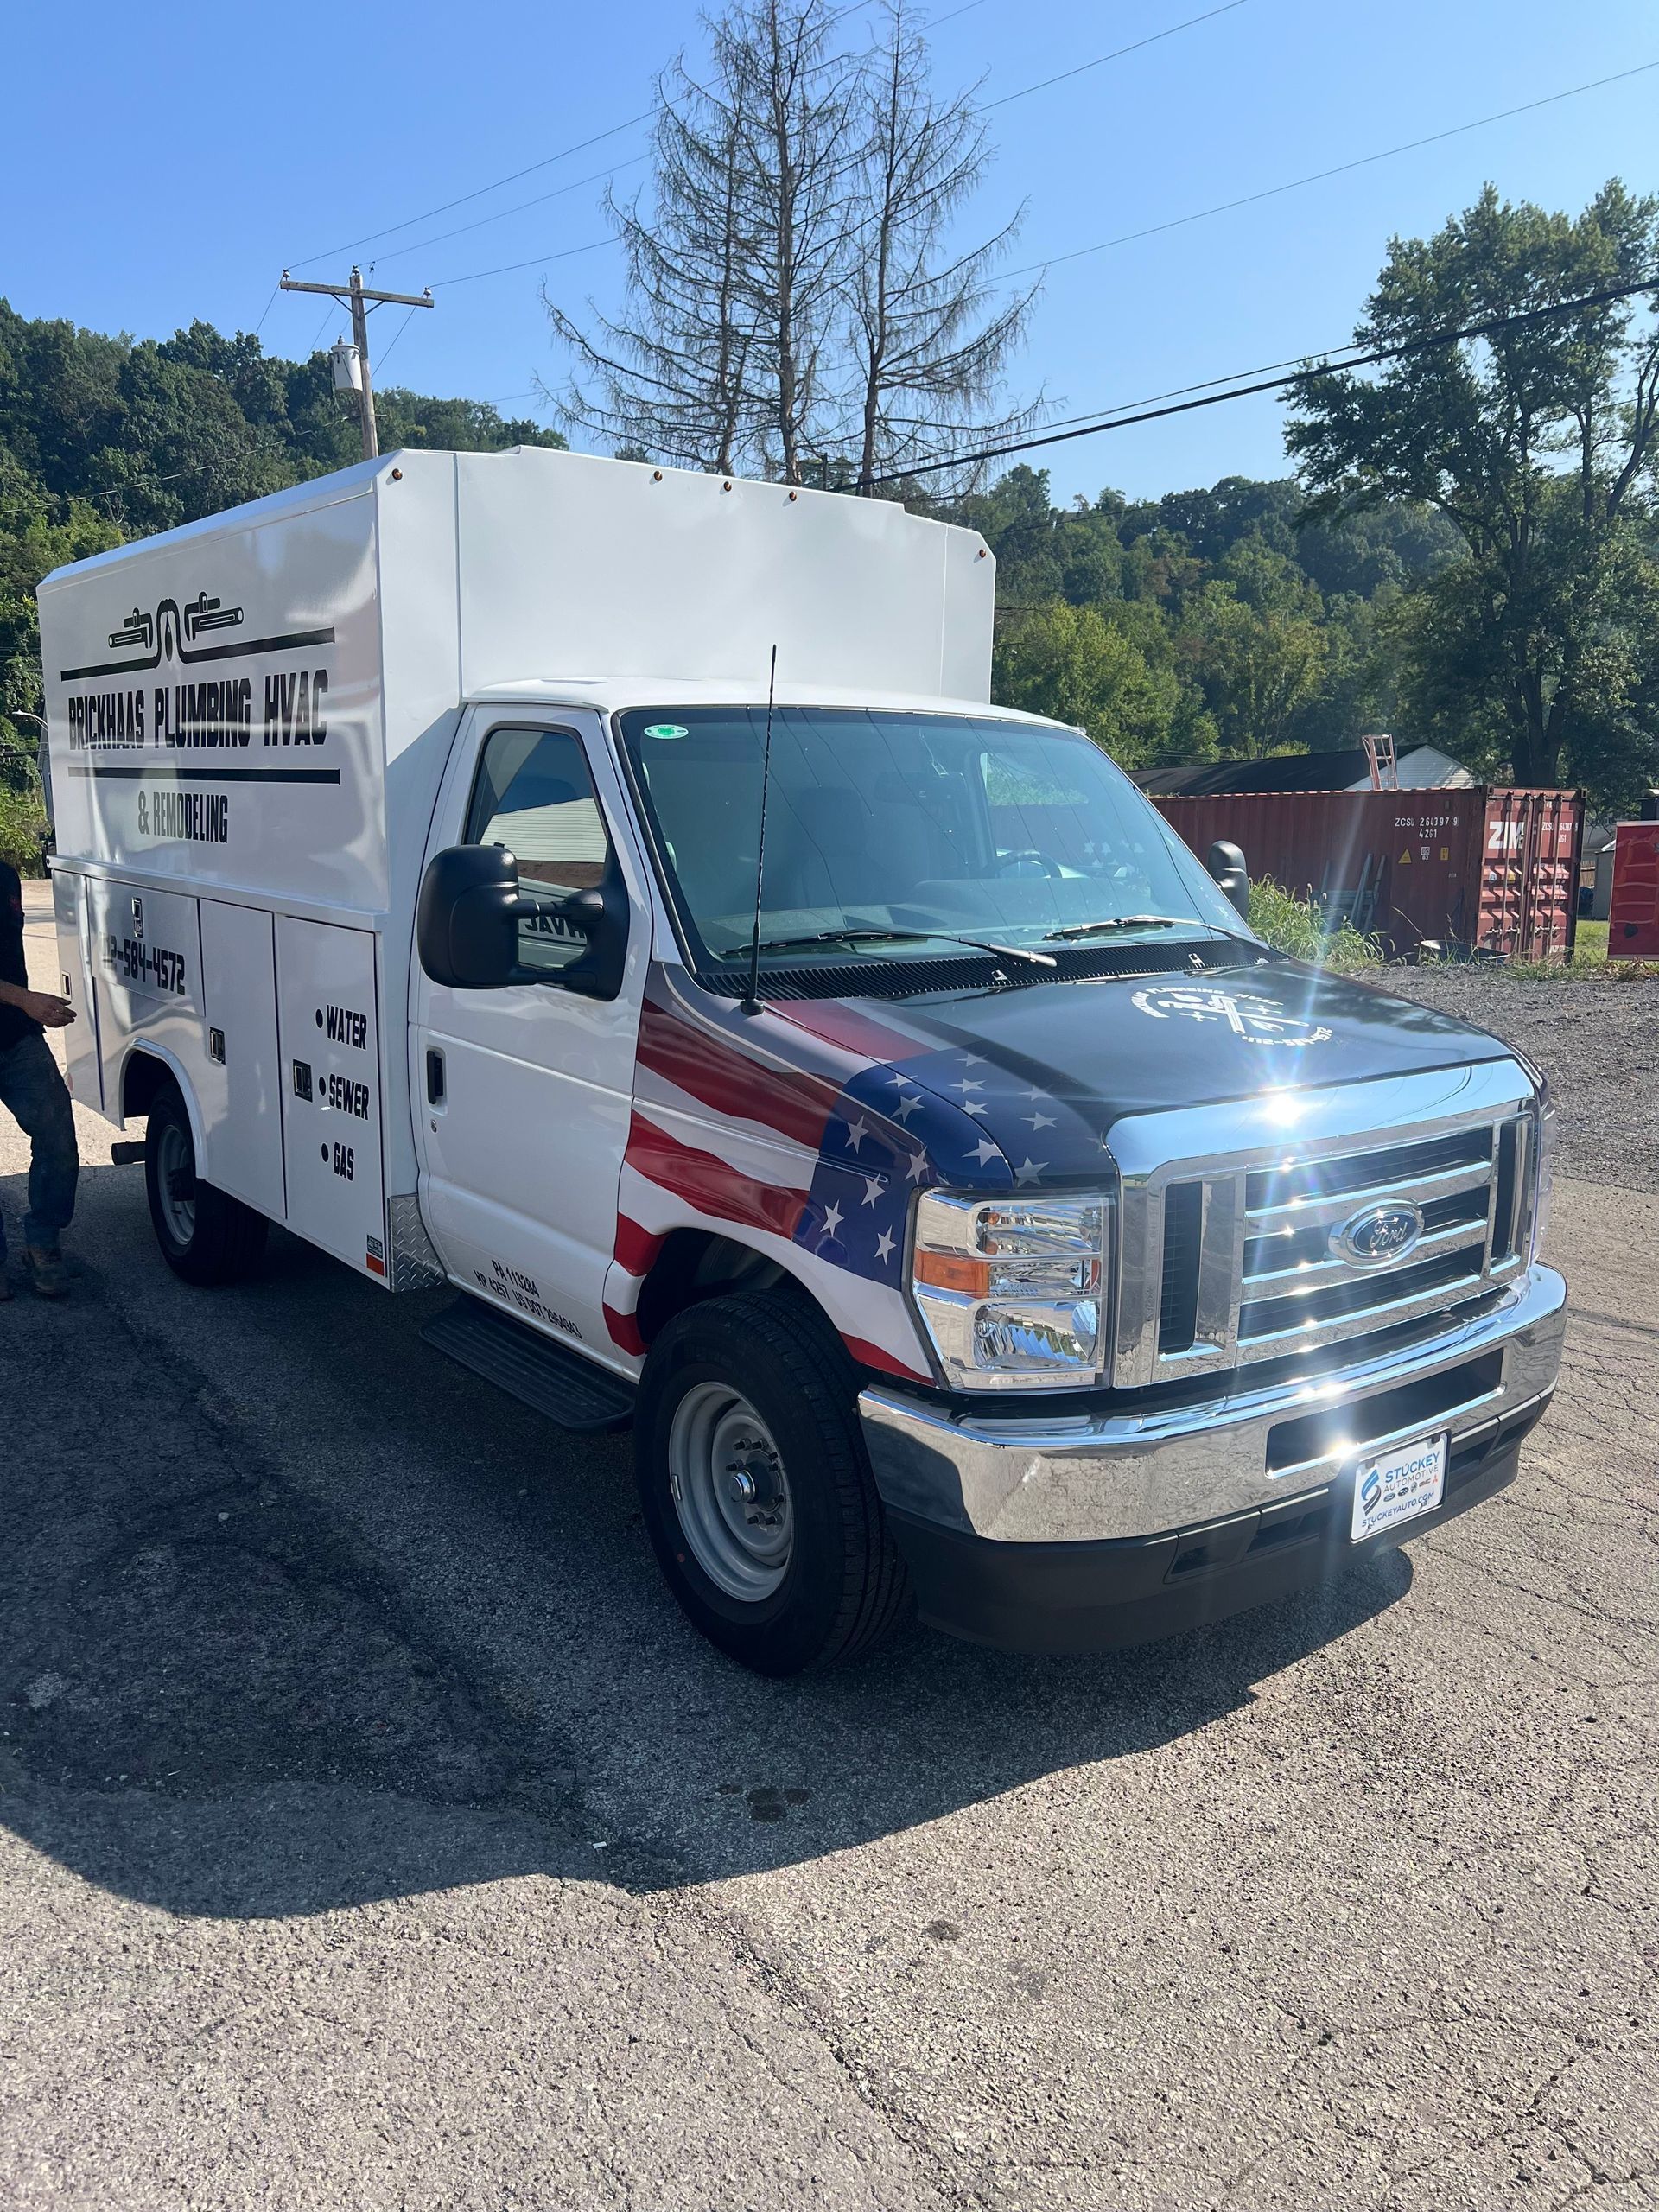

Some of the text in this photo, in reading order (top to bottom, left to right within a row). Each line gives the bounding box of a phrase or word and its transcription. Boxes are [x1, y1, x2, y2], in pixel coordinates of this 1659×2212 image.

[68, 669, 329, 751] BRICKHAAS PLUMBING HVAC
[138, 791, 228, 844] & REMODELING
[1487, 821, 1525, 849] ZIM
[326, 1004, 367, 1051] WATER
[328, 1073, 370, 1121] SEWER
[333, 1141, 354, 1181] GAS
[1369, 1216, 1408, 1249] Ford
[491, 1259, 508, 1281] PA
[512, 1289, 528, 1311] US
[525, 1297, 546, 1319] DOT
[1383, 1465, 1439, 1493] AUTOMOTIVE
[1361, 1491, 1434, 1528] STUCKEYAUTO.COM
